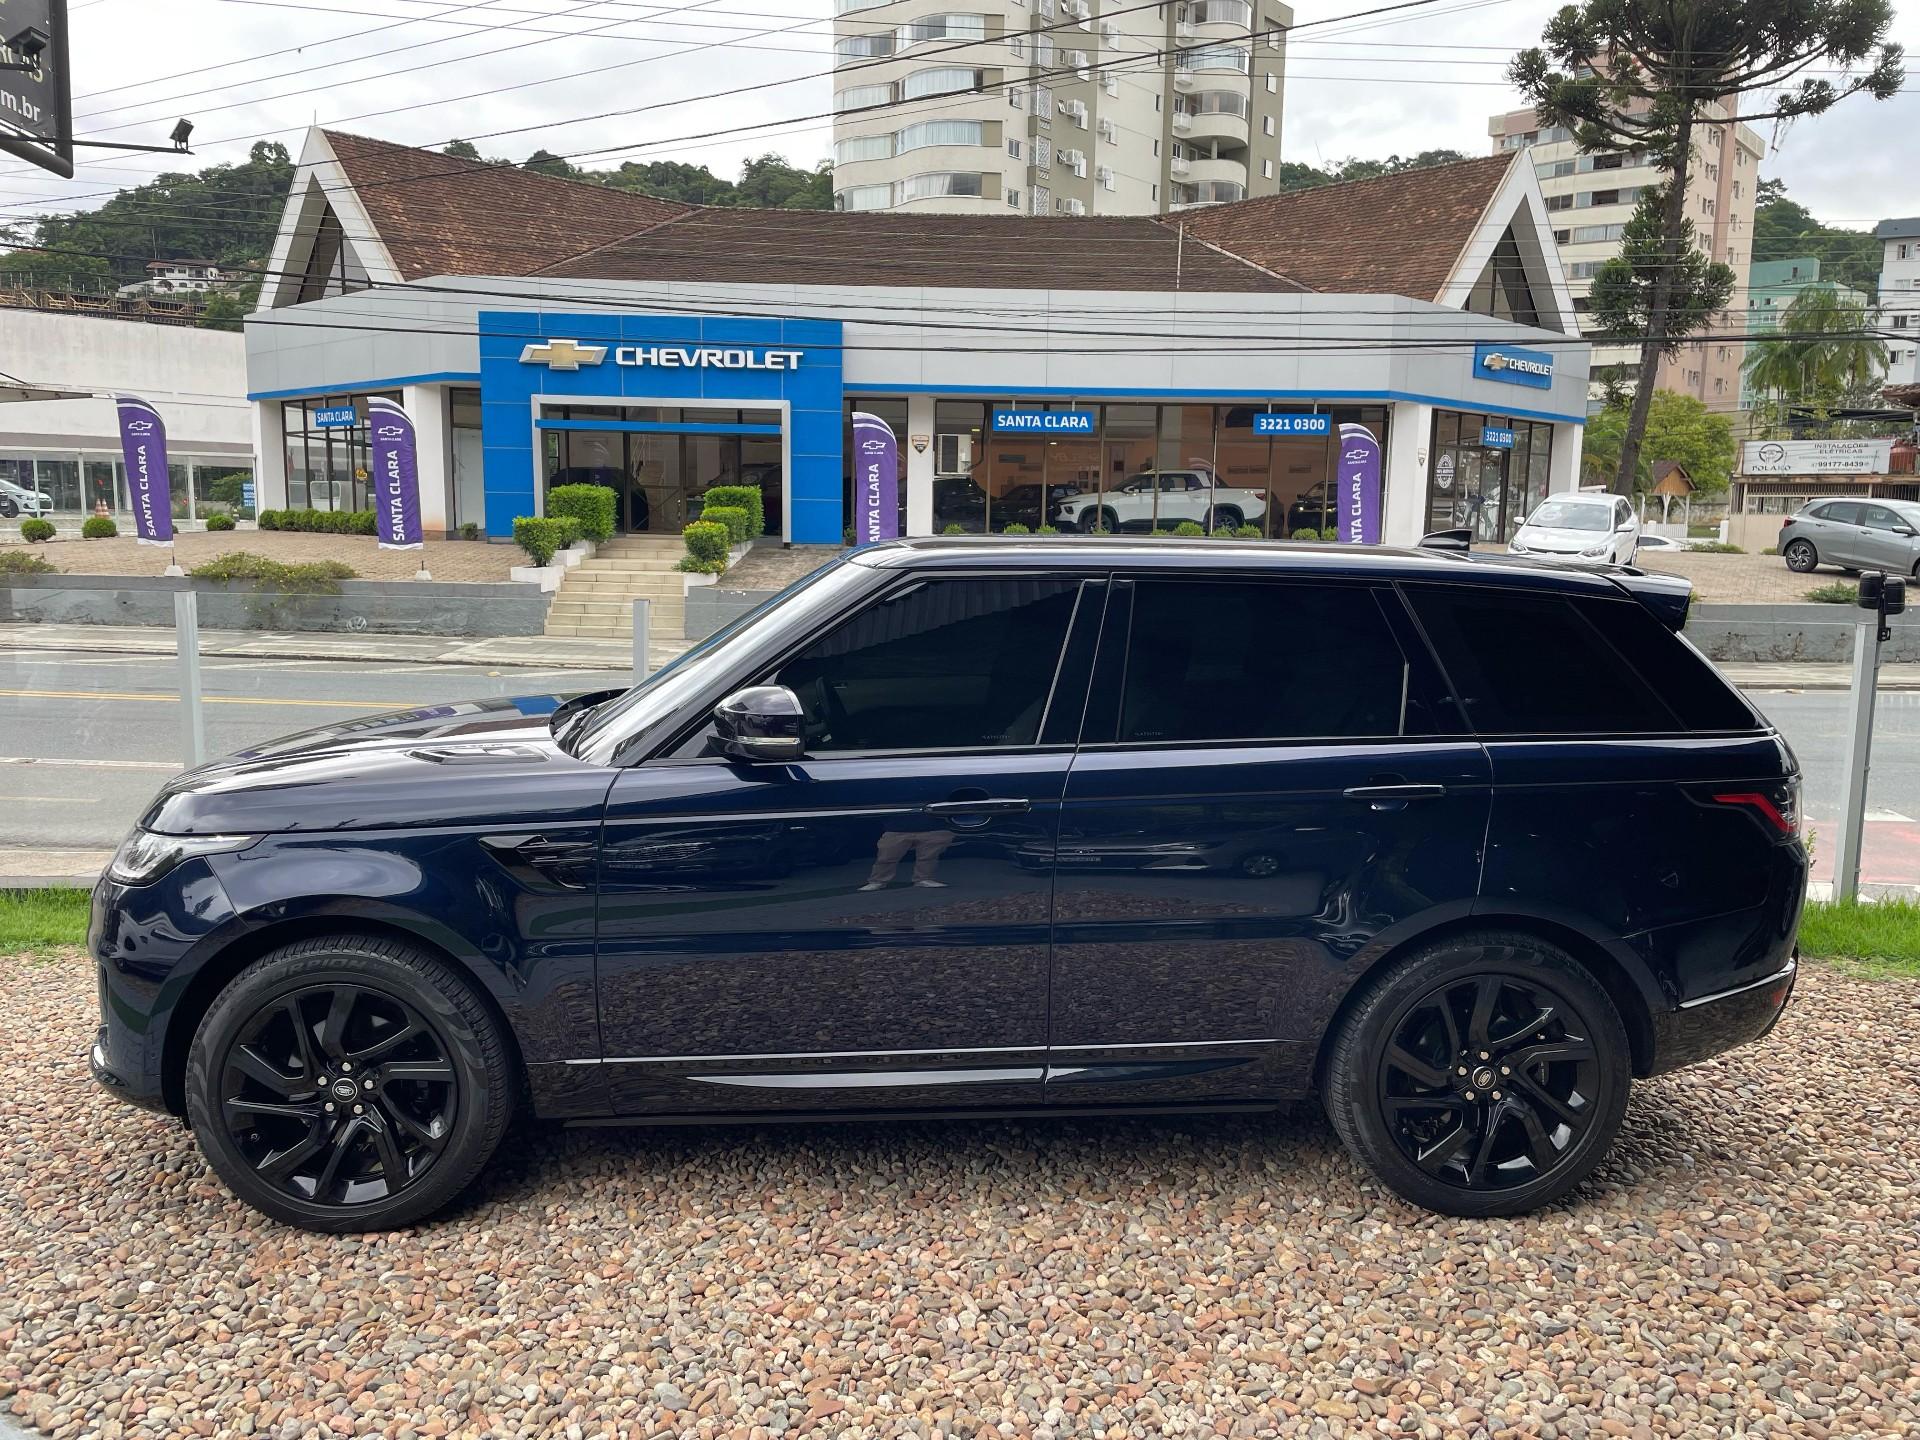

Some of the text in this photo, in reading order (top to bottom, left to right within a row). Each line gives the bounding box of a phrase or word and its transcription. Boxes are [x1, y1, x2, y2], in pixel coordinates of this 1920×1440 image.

[615, 347, 804, 370] CHEVROLET
[1509, 358, 1554, 377] CHEVROLET
[316, 410, 354, 423] SANTA CLARA
[997, 415, 1089, 428] SANTA CLARA
[1260, 418, 1325, 430] 3221 0300
[1486, 431, 1499, 442] 3221
[137, 445, 149, 490] CLARA
[387, 450, 401, 495] CLARA
[868, 463, 880, 507] CLARA
[1351, 472, 1362, 516] CLARA
[141, 493, 157, 537] SANTA
[390, 498, 404, 541] SANTA
[868, 509, 880, 542] ANTA
[1351, 518, 1363, 544] NTA
